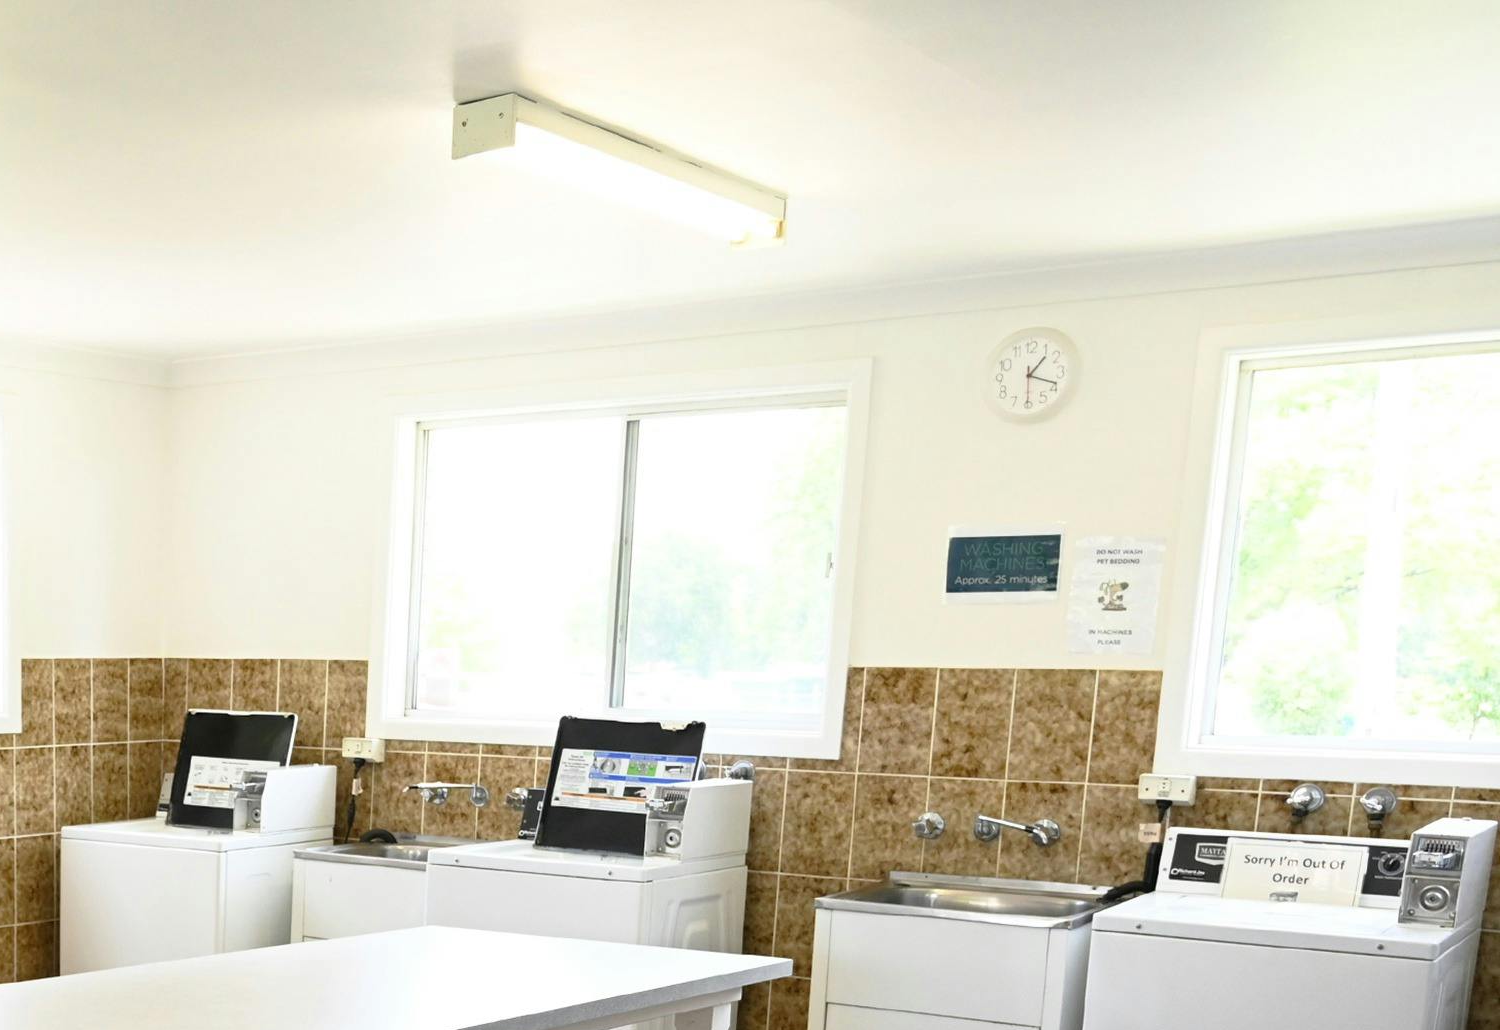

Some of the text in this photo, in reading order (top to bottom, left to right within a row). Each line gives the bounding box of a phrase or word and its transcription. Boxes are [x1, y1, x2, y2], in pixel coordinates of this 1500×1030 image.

[1013, 346, 1021, 358] 11
[1026, 341, 1038, 354] 12
[1052, 350, 1061, 364] 2
[1000, 359, 1012, 372] 10
[1057, 365, 1065, 379] 3
[996, 373, 1004, 385] 9
[999, 385, 1007, 399] 8
[1050, 382, 1057, 392] 4
[1011, 396, 1018, 407] 7
[1039, 391, 1047, 404] 5
[964, 541, 1044, 556] WASHING
[960, 557, 1045, 571] MACHINES
[954, 575, 1048, 585] Approx. 25 minutes
[1200, 847, 1227, 856] MAYTA
[1244, 854, 1347, 870] Sorry I'm Out Of
[1272, 873, 1310, 885] Order
